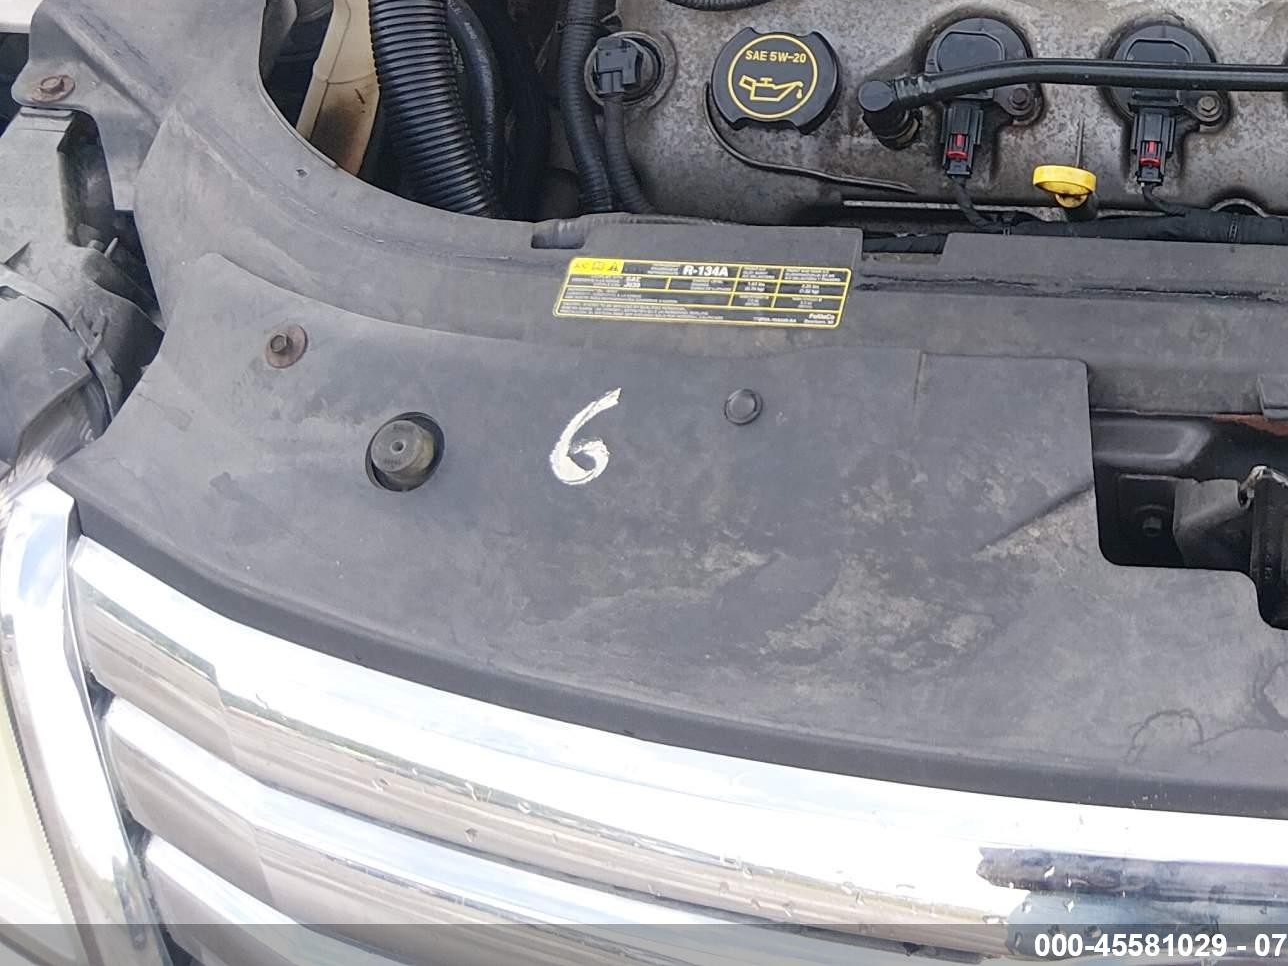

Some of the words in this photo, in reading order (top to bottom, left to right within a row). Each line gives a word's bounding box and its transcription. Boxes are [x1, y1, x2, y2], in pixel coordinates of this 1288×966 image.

[745, 49, 769, 62] SAE
[769, 51, 808, 64] 5W-20
[683, 264, 729, 277] R-134A
[549, 387, 622, 485] 6
